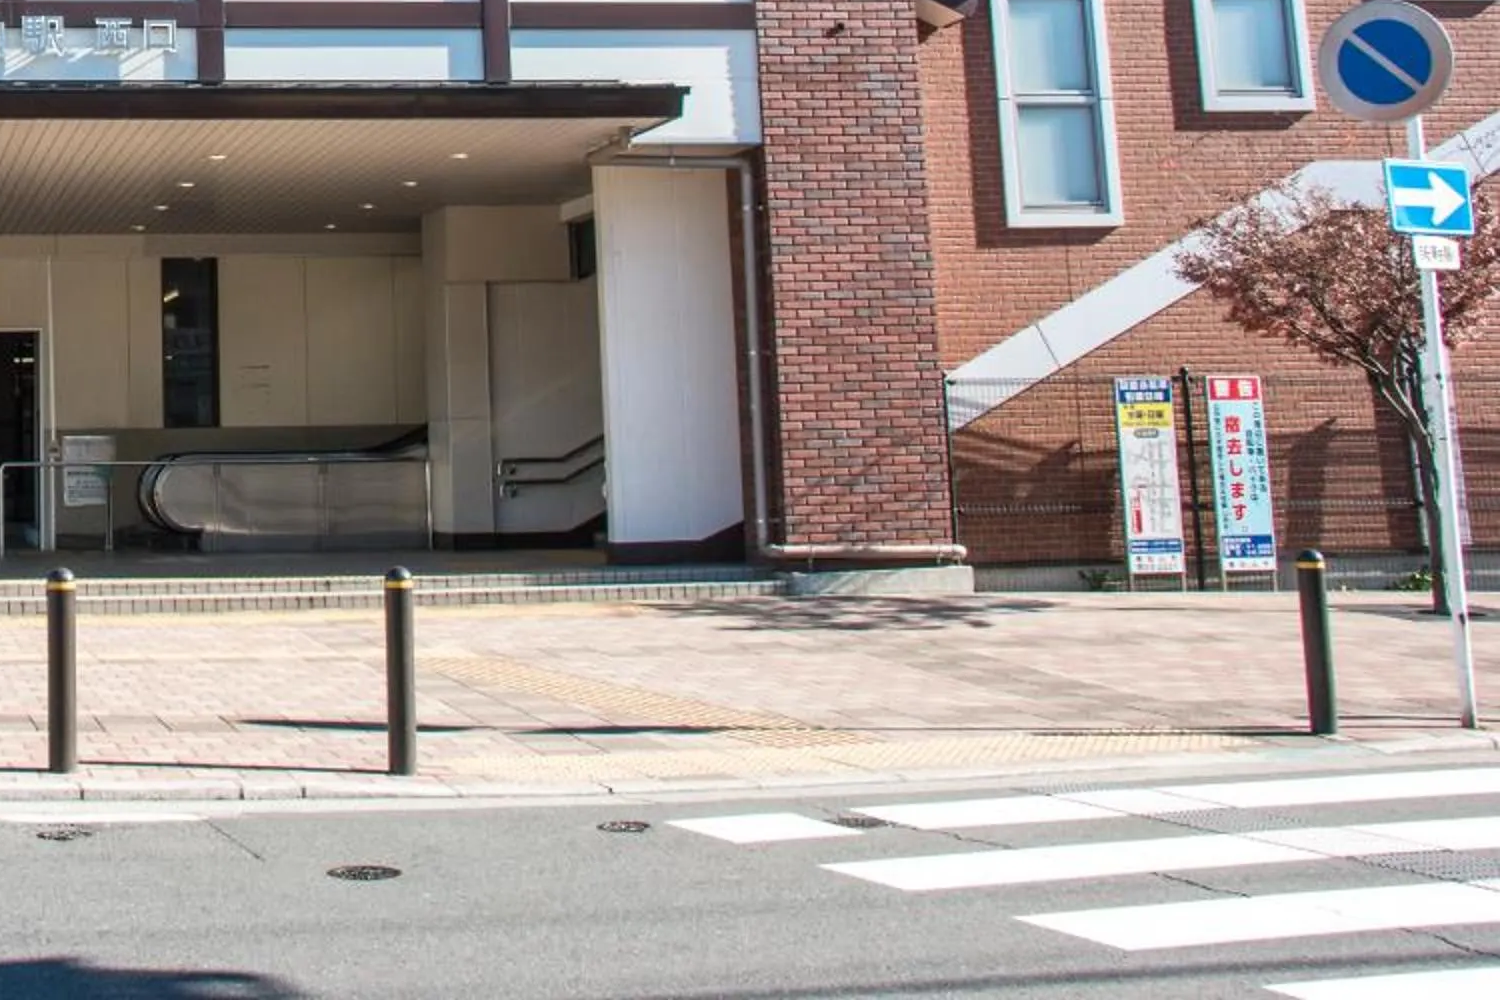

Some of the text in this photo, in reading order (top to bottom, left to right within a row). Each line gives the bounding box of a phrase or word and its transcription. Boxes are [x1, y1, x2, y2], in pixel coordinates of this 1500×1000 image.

[94, 16, 178, 53] 西口
[1224, 415, 1247, 521] 撤去します
